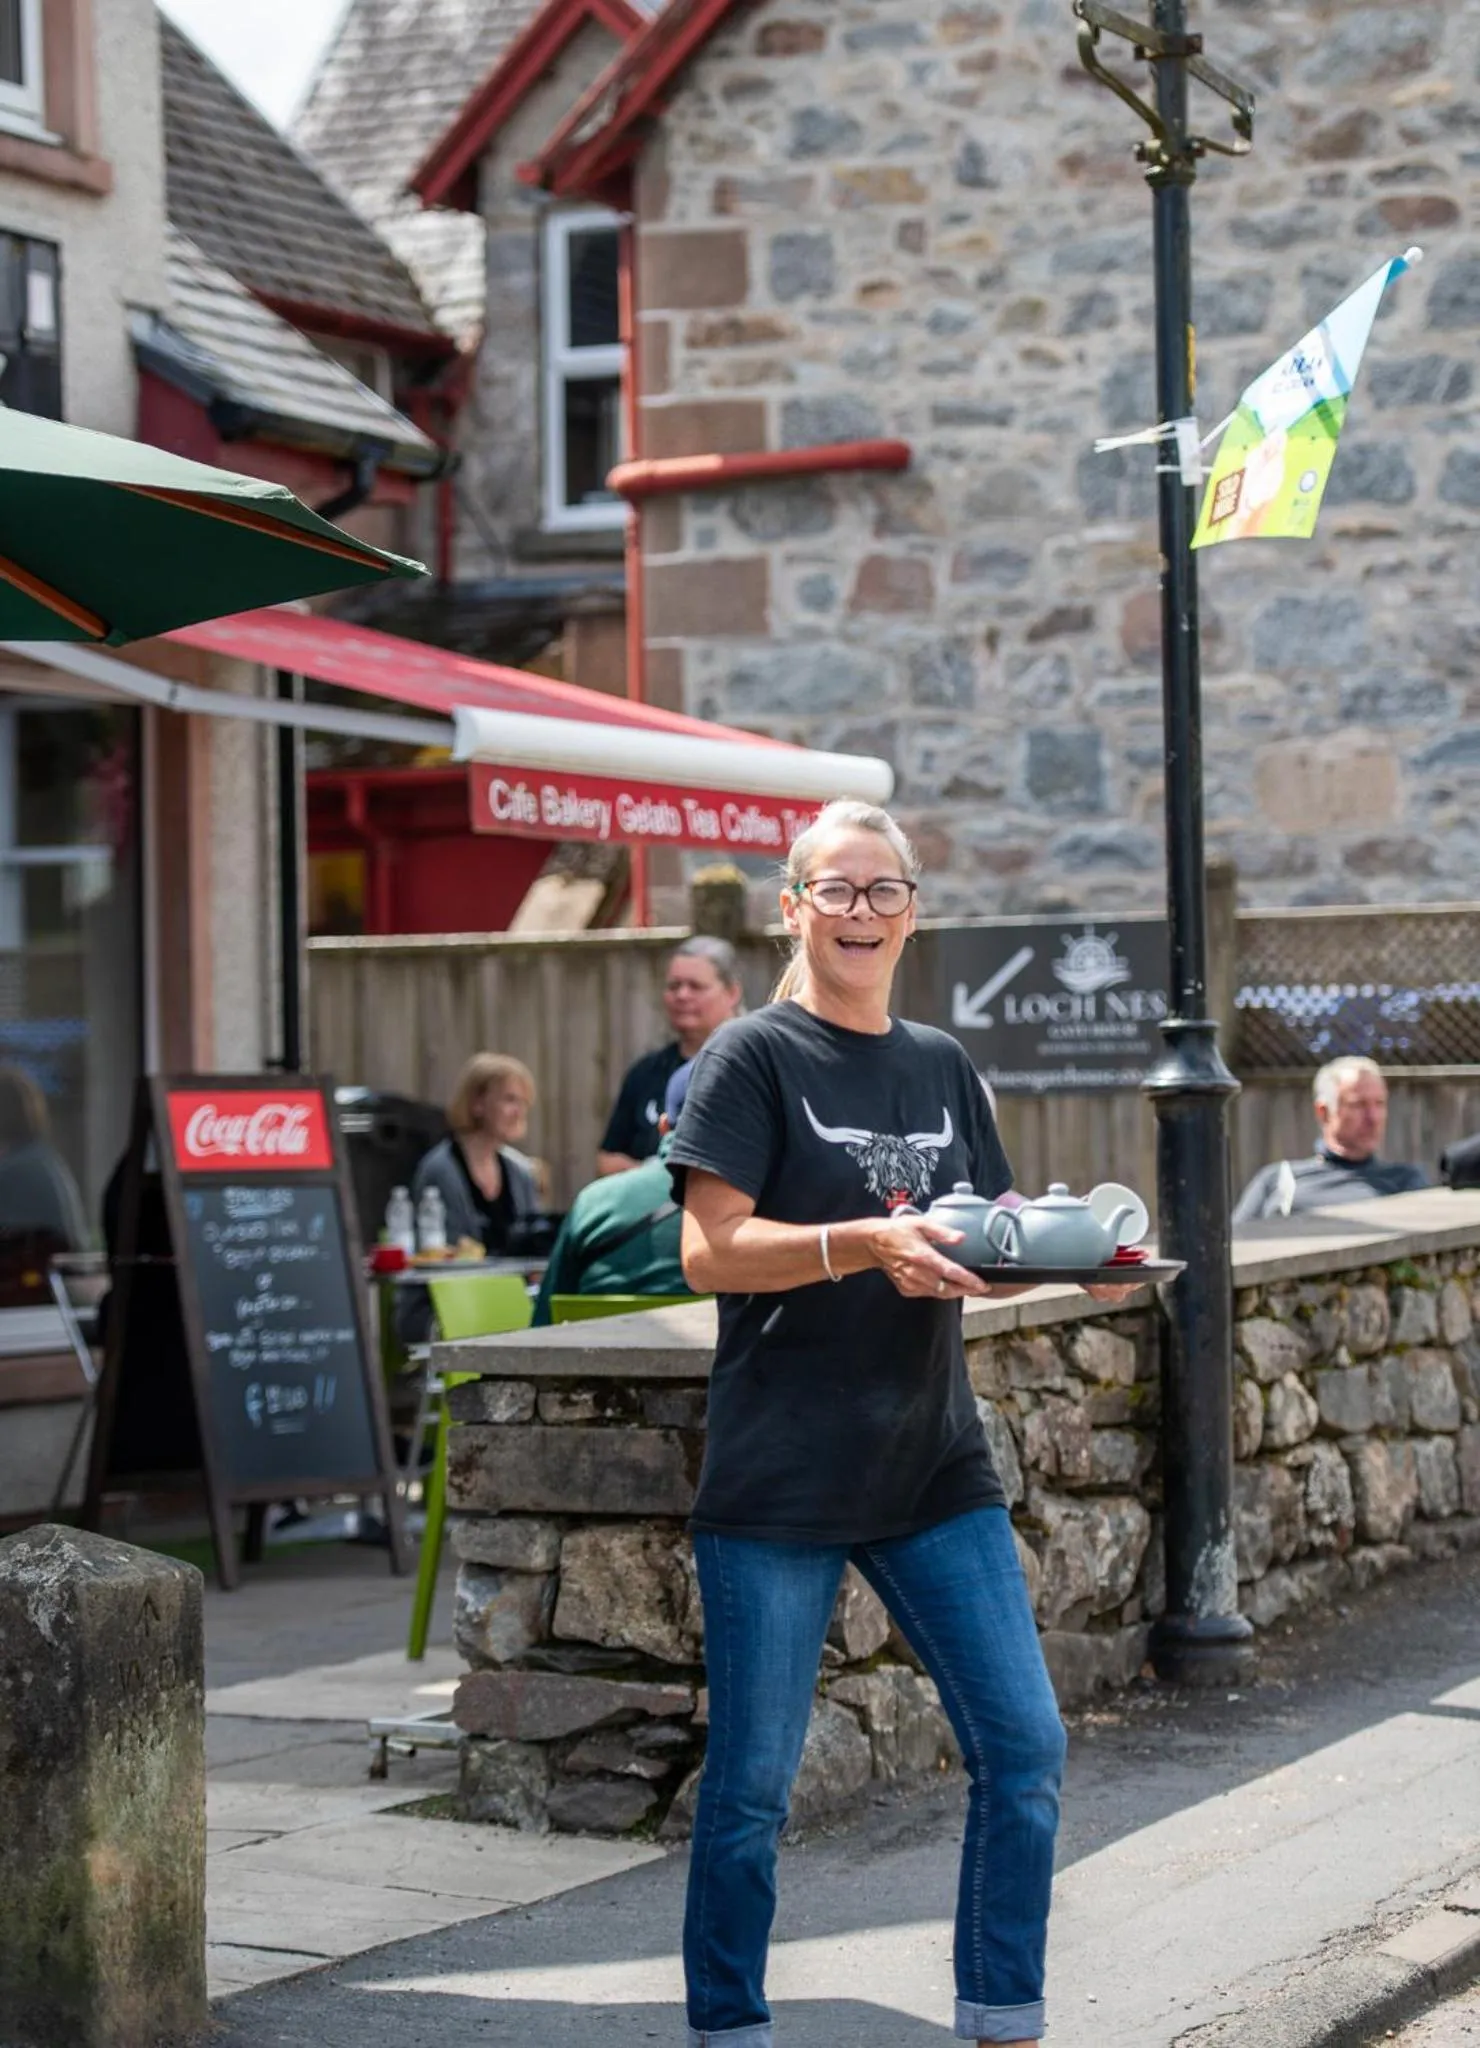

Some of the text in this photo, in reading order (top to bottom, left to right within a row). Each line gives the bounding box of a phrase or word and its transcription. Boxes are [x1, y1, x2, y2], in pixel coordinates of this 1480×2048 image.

[541, 785, 612, 840] Bakery
[616, 793, 682, 837] Gelato
[681, 798, 721, 840] Tea
[721, 802, 782, 846] Coffee
[1004, 989, 1169, 1024] LOCH NES
